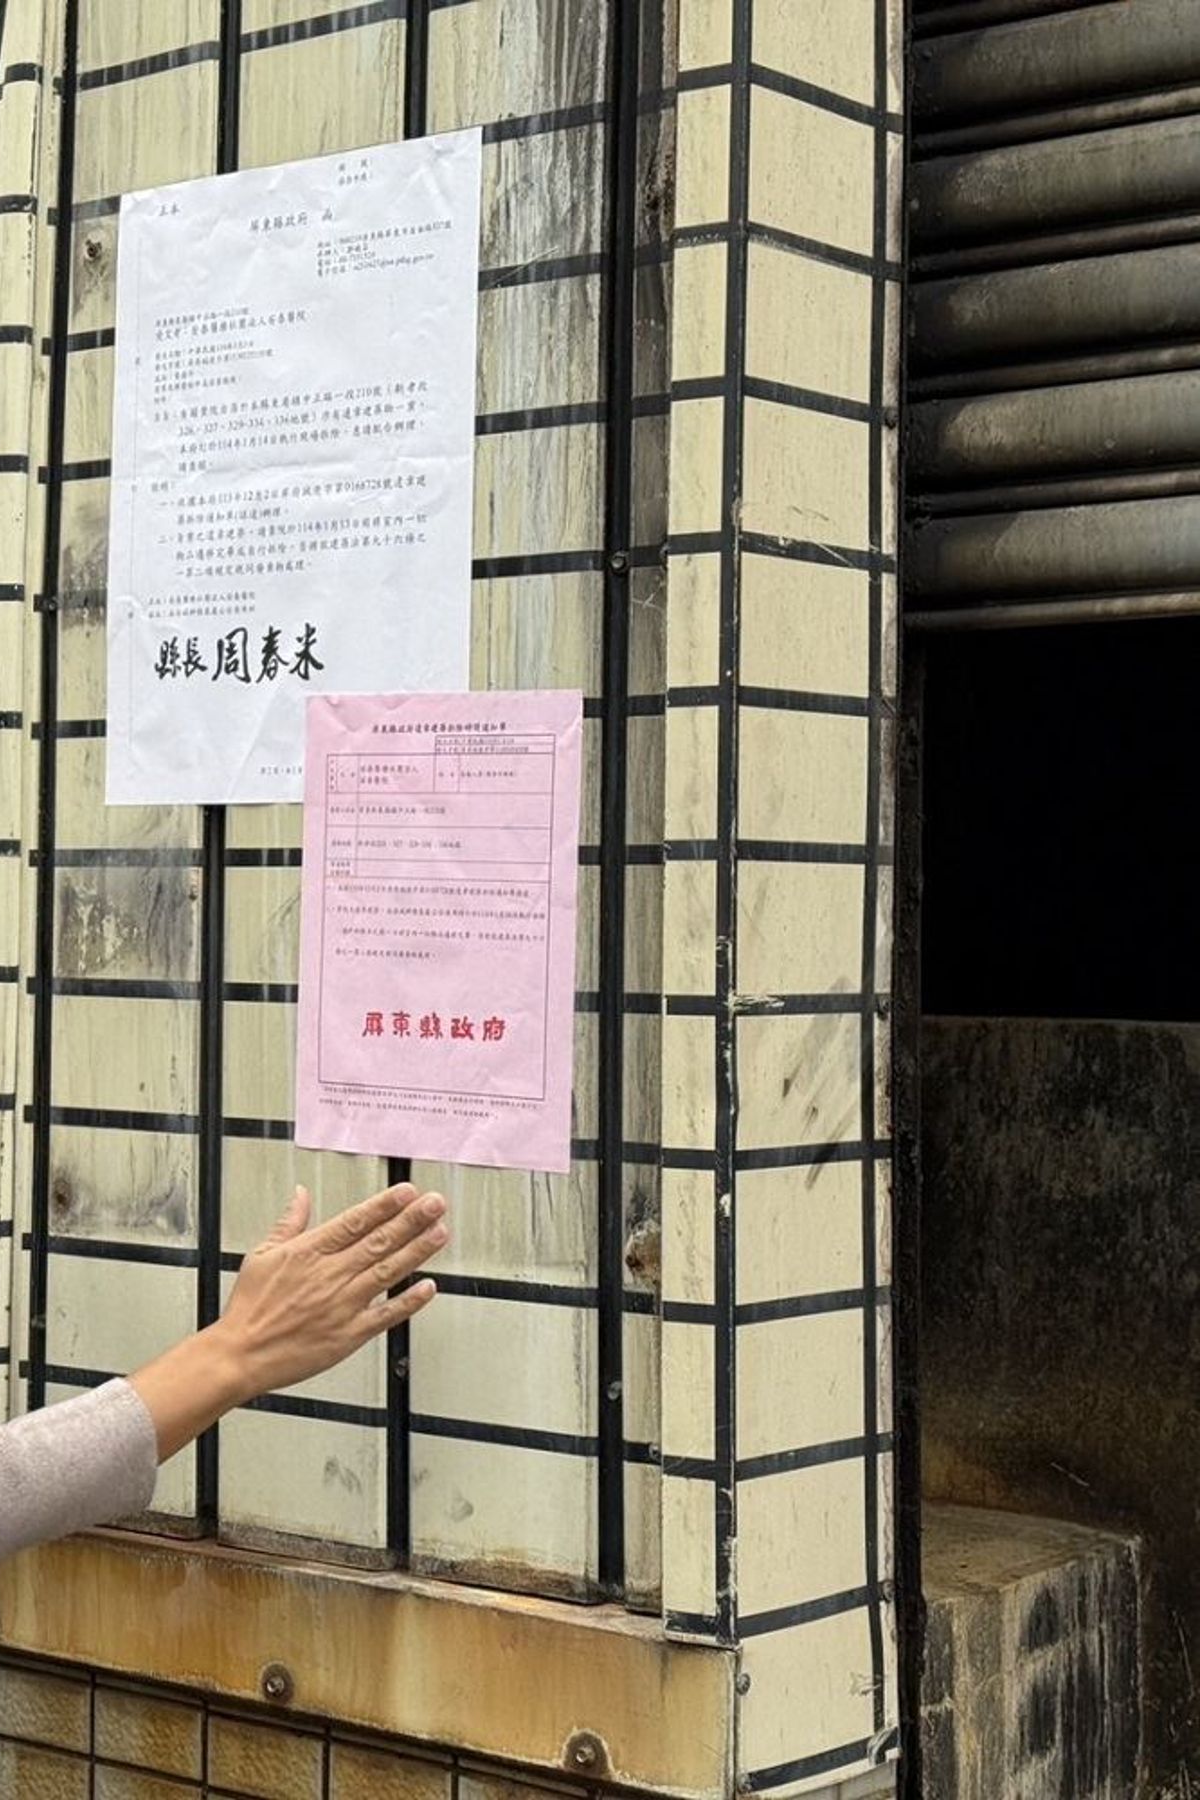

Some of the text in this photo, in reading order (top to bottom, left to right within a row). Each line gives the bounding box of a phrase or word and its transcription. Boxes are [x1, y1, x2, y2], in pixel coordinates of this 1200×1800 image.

[249, 212, 309, 232] 屏東縣政府
[362, 1010, 507, 1042] 屏東縣政府
